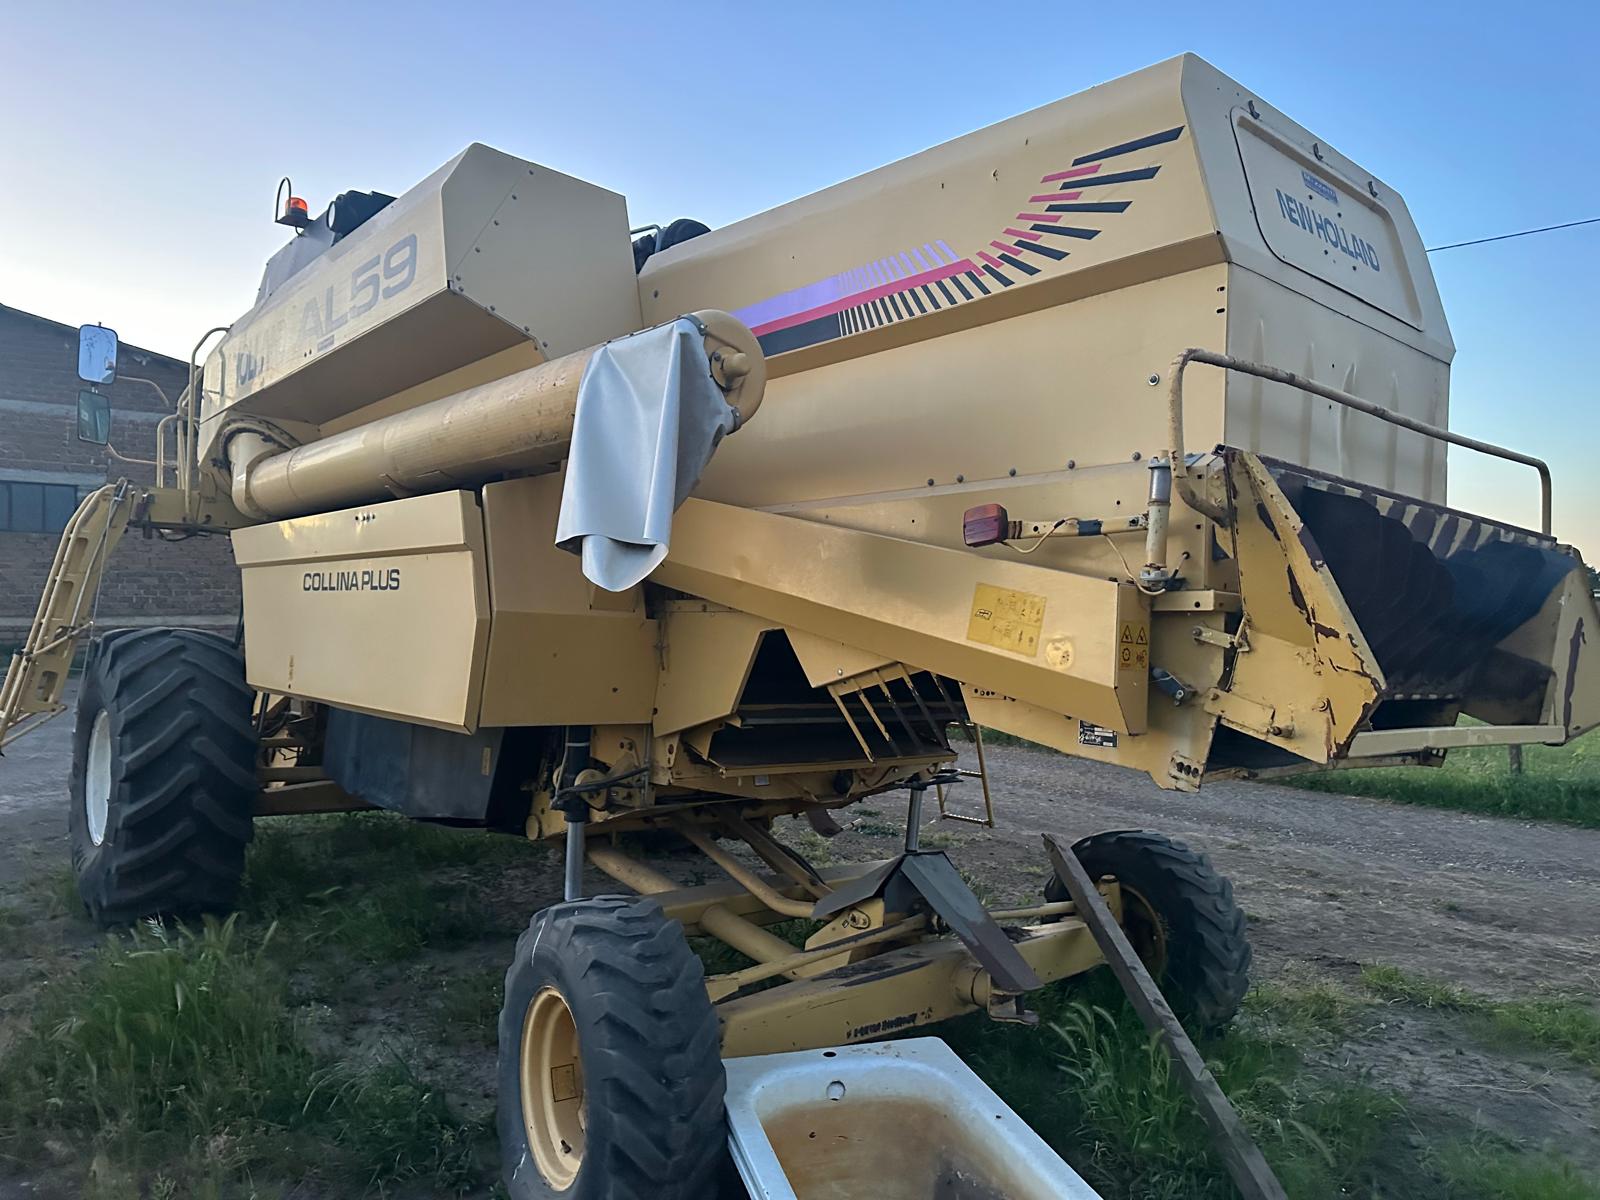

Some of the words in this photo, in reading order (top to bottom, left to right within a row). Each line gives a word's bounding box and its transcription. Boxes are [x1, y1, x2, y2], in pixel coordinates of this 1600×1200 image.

[1275, 188, 1314, 235] NEW
[1312, 209, 1380, 272] HOLLAND
[303, 572, 358, 591] COLLINA
[361, 569, 400, 591] PLUS
